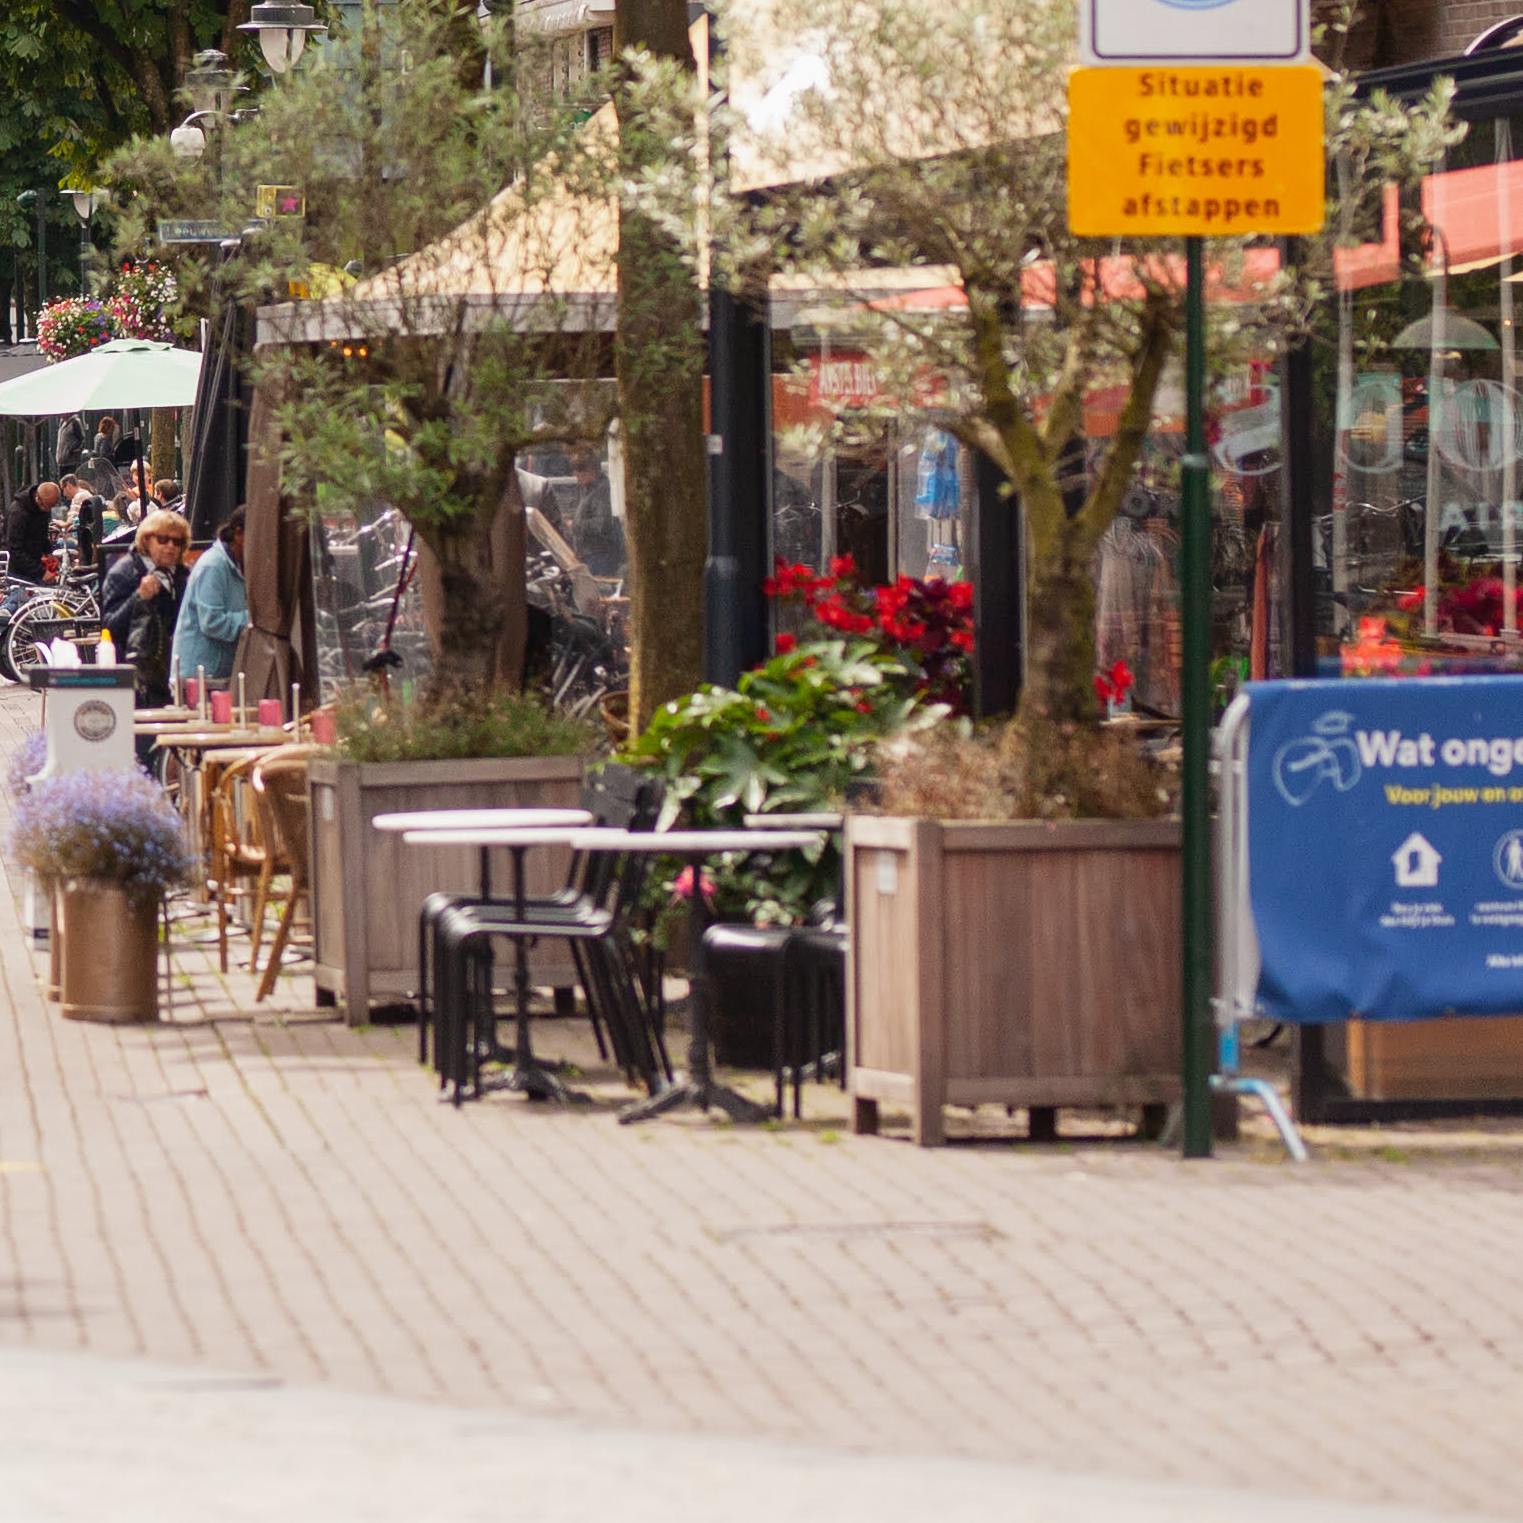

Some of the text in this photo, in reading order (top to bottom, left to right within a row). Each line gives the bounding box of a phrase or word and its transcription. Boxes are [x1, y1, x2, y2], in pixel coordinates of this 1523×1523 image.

[1138, 73, 1265, 98] Situatie
[1123, 113, 1280, 144] gewijzigd
[1138, 152, 1265, 179] Fietsers
[1122, 193, 1281, 222] afstappen
[1354, 728, 1436, 768] Wat
[1384, 783, 1429, 806] Voor
[1430, 782, 1479, 810] jouw
[1481, 785, 1506, 804] en
